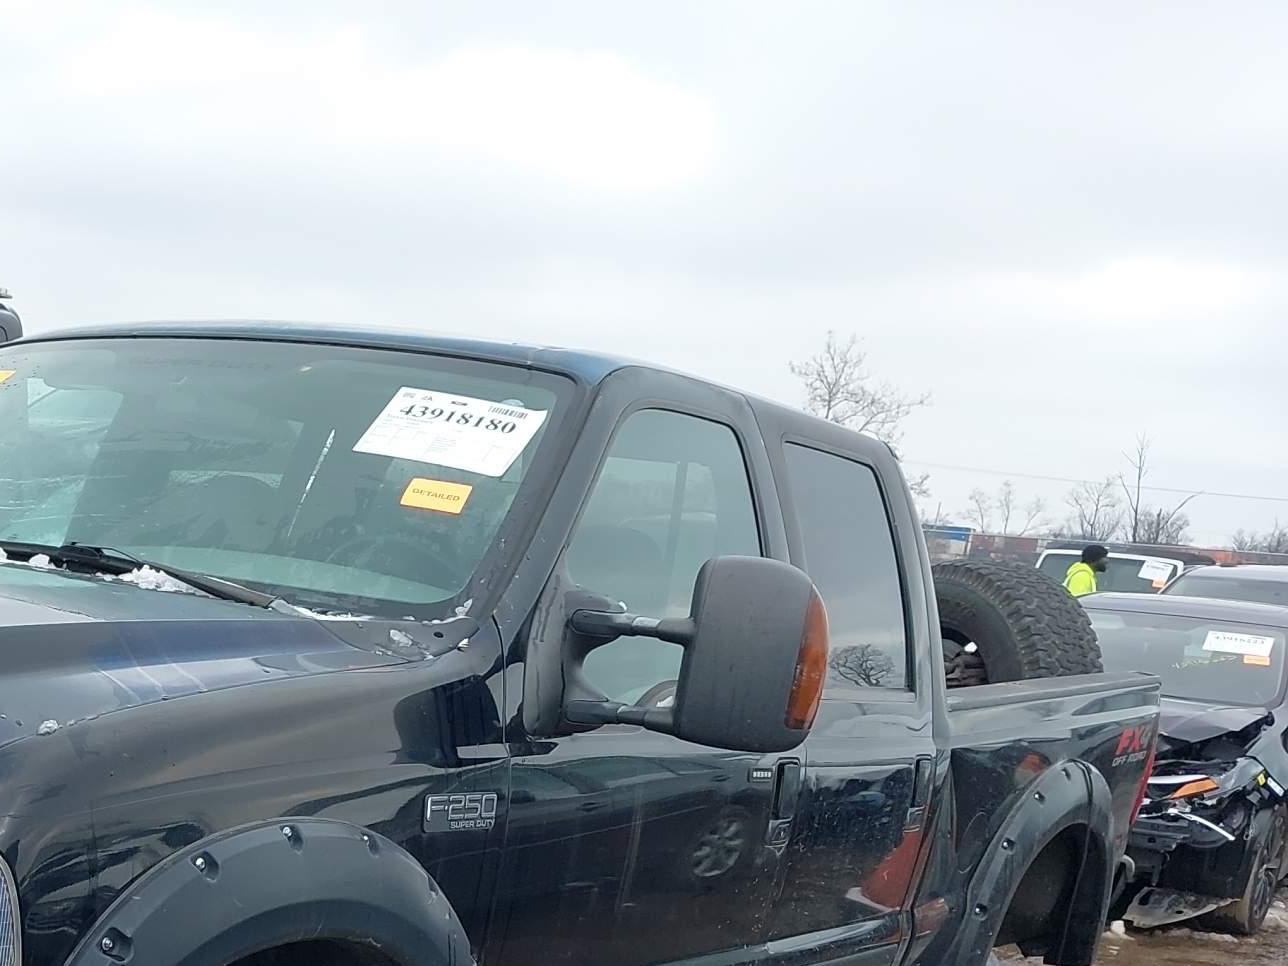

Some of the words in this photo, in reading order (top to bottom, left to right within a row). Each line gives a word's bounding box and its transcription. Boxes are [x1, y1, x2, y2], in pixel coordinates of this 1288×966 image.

[399, 403, 517, 434] 43918180
[412, 488, 461, 502] DETAILED
[450, 820, 475, 829] SUPER
[475, 819, 496, 831] DUTY
